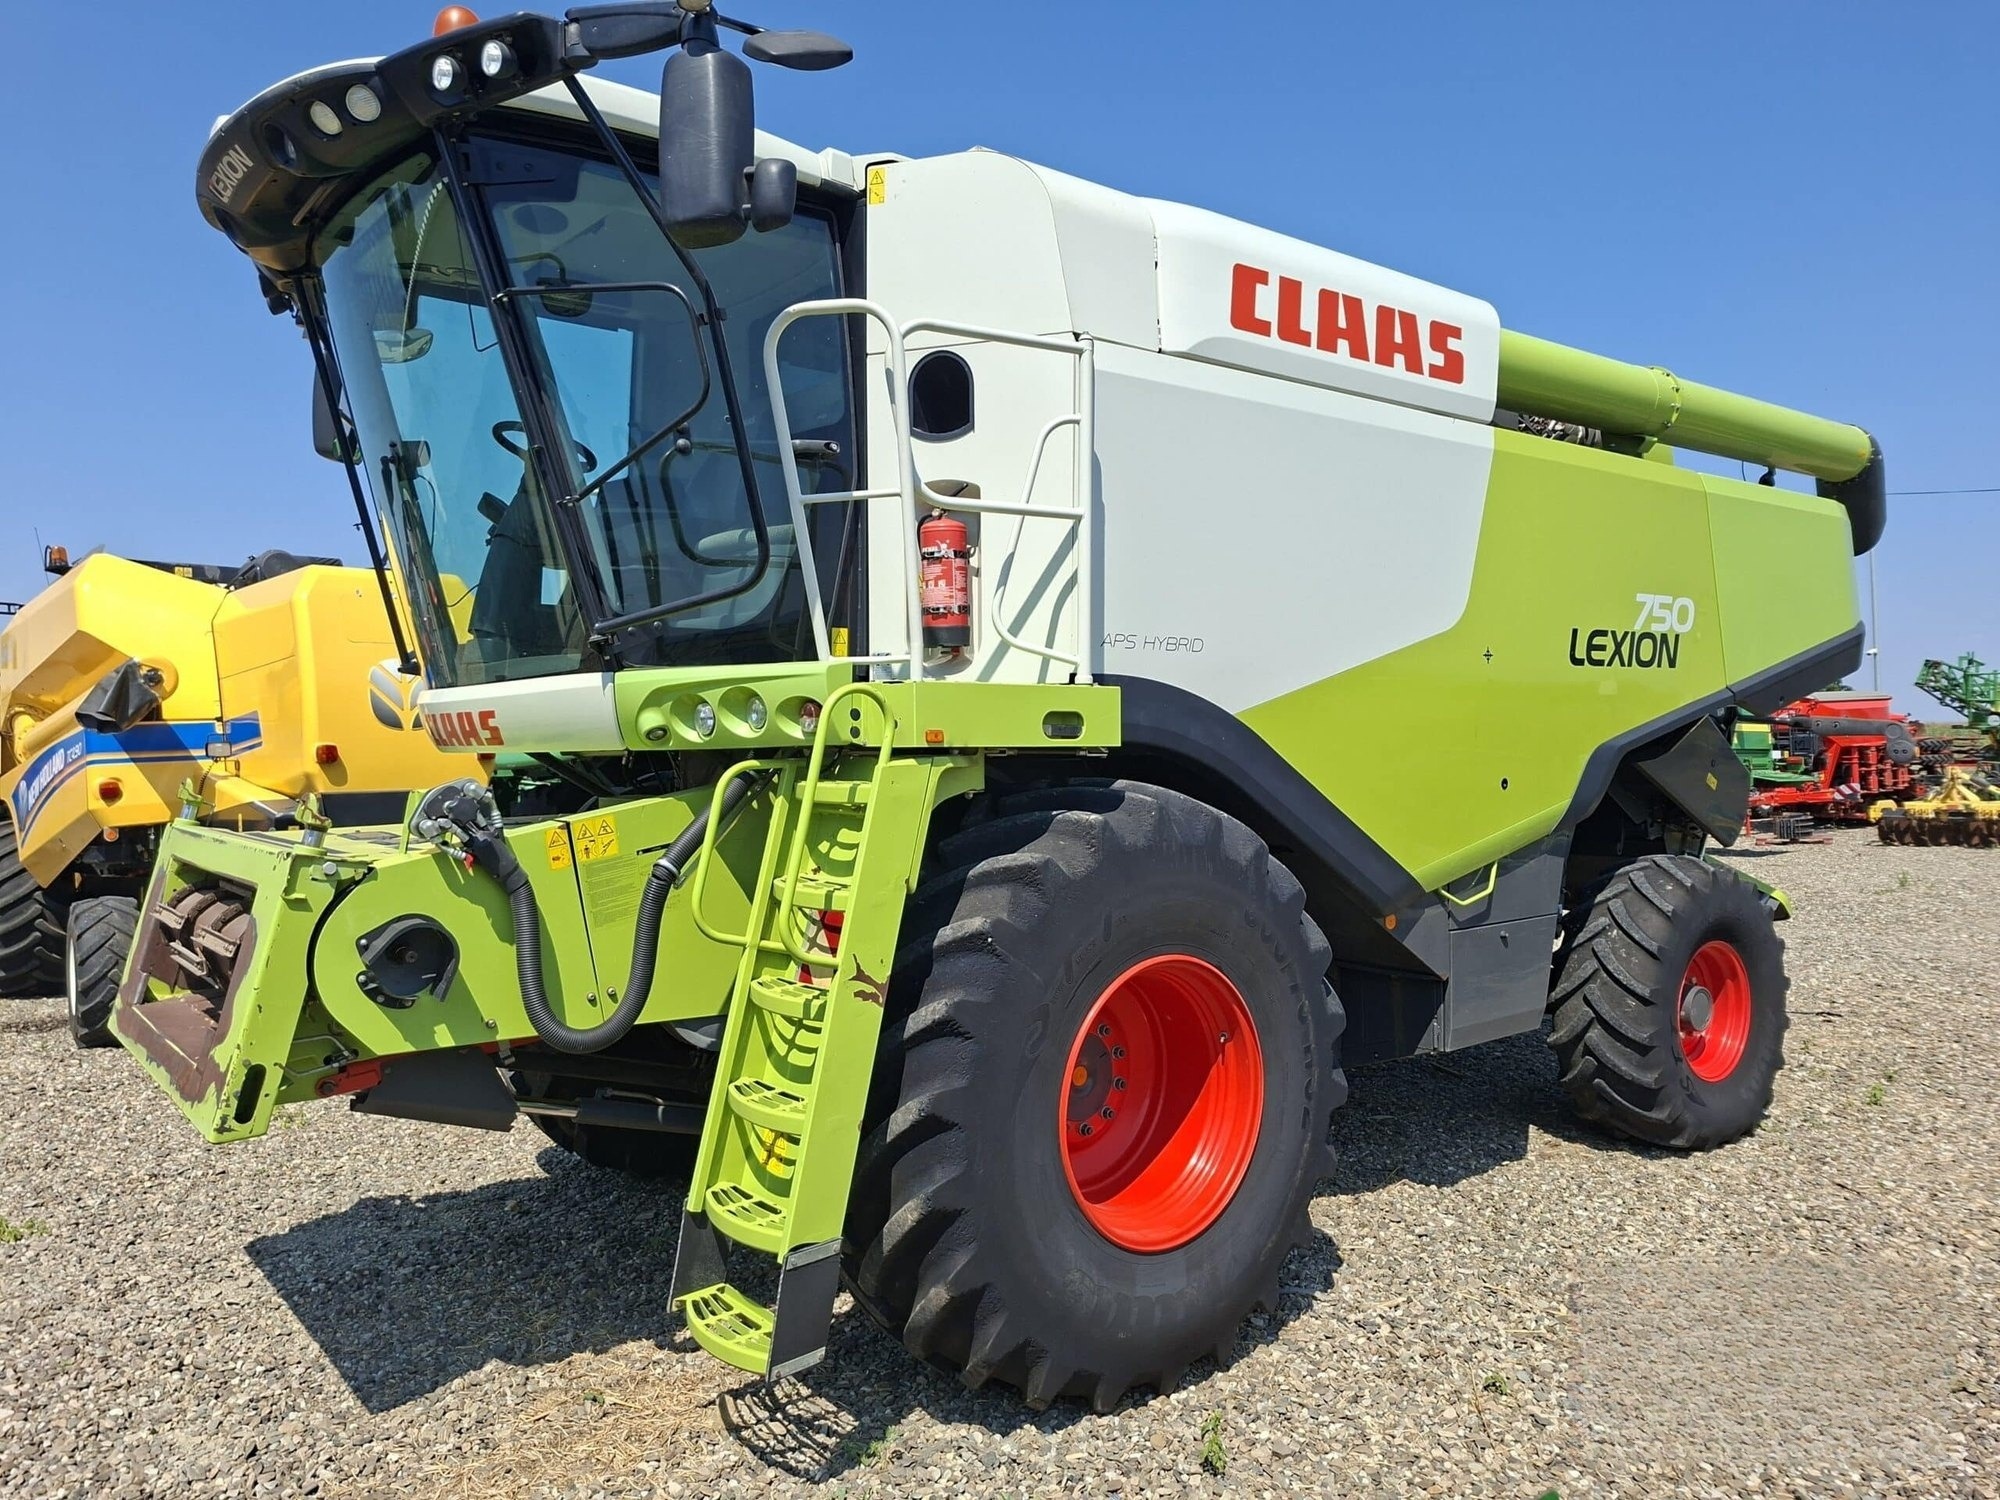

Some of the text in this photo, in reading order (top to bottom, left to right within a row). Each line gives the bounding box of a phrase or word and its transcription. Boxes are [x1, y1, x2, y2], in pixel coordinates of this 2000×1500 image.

[208, 144, 254, 203] LEXION
[1230, 262, 1464, 385] CLAAS
[1633, 592, 1696, 633] 750
[1100, 633, 1204, 653] APS HYBRID
[1569, 628, 1680, 668] LEXION
[28, 774, 40, 812] NEW
[40, 748, 65, 793] HOLLAND
